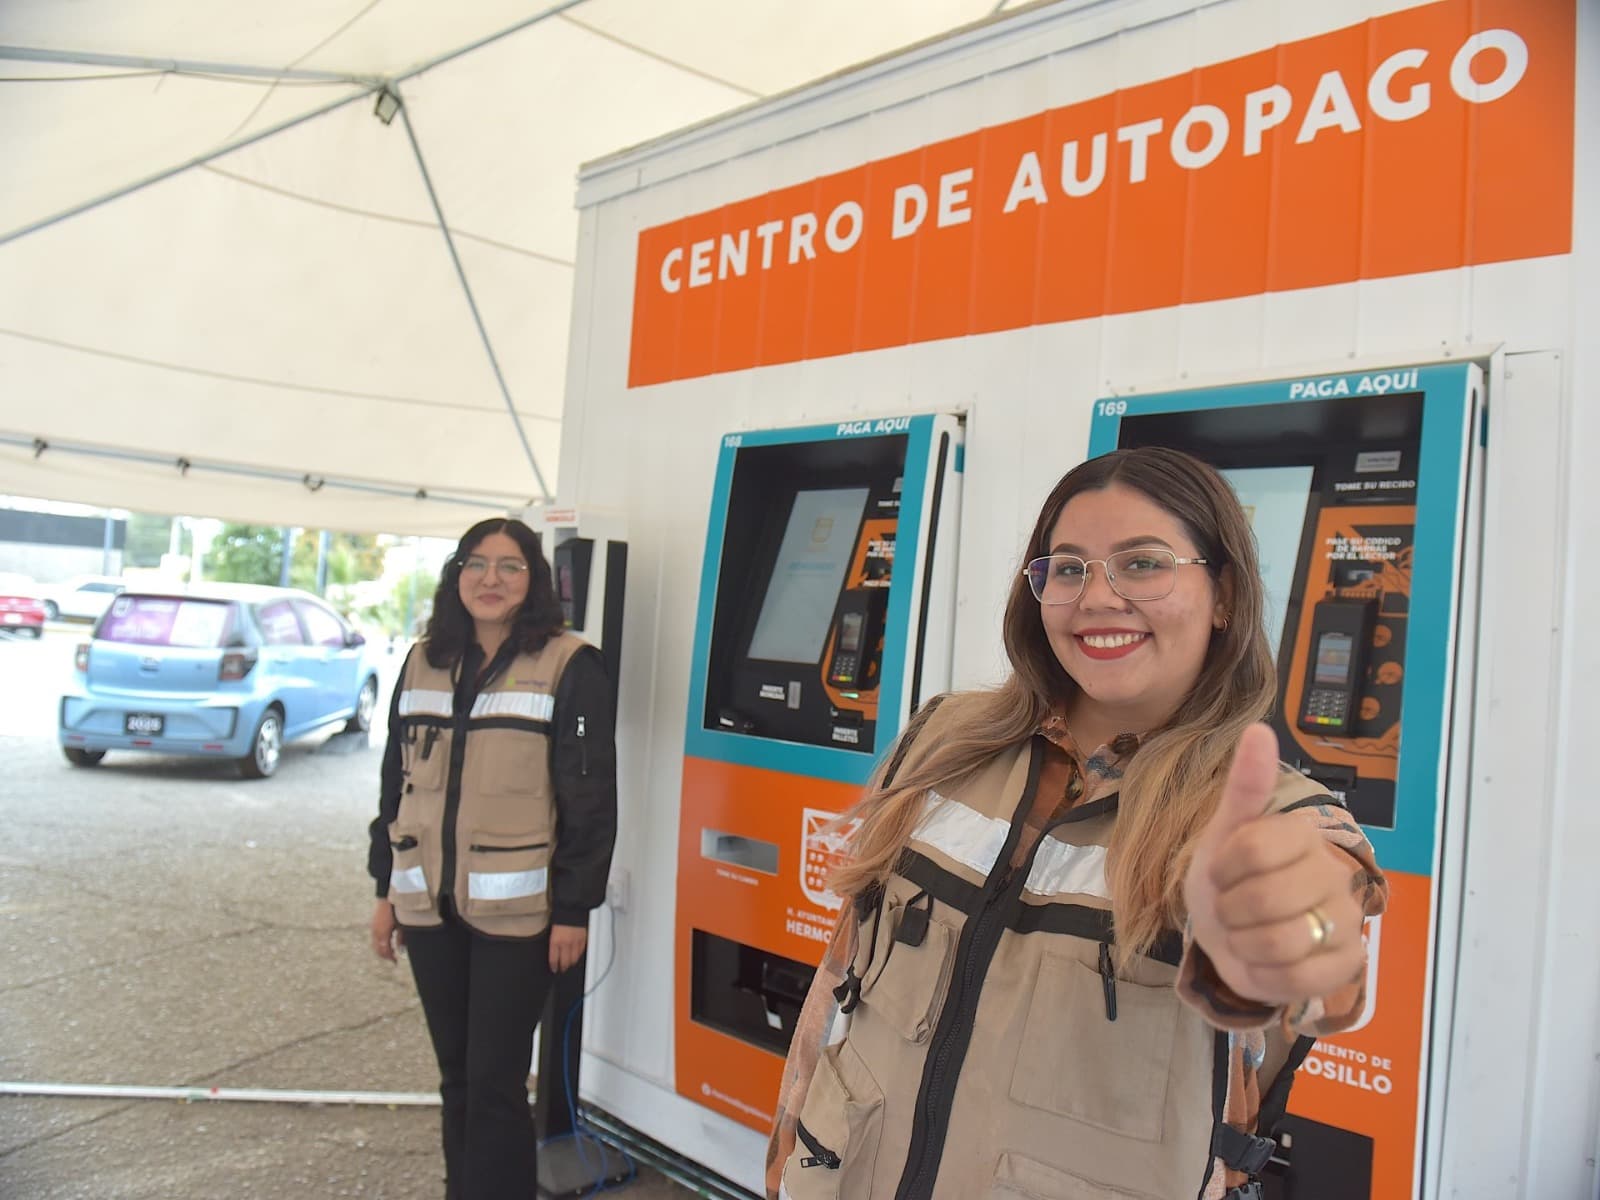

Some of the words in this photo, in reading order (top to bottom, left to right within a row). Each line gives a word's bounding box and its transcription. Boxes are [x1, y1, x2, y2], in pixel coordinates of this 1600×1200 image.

[660, 201, 864, 293] CENTRO
[892, 168, 973, 239] DE
[1003, 29, 1528, 213] AUTOPAGO
[1289, 379, 1349, 399] PAGA
[1356, 368, 1419, 395] AQUÍ
[1097, 400, 1127, 416] 169
[836, 421, 871, 436] PAGA
[786, 918, 833, 944] HERMO
[1311, 1041, 1366, 1063] MIENTO
[1371, 1056, 1392, 1070] DE
[1298, 1055, 1392, 1094] OSILLO
